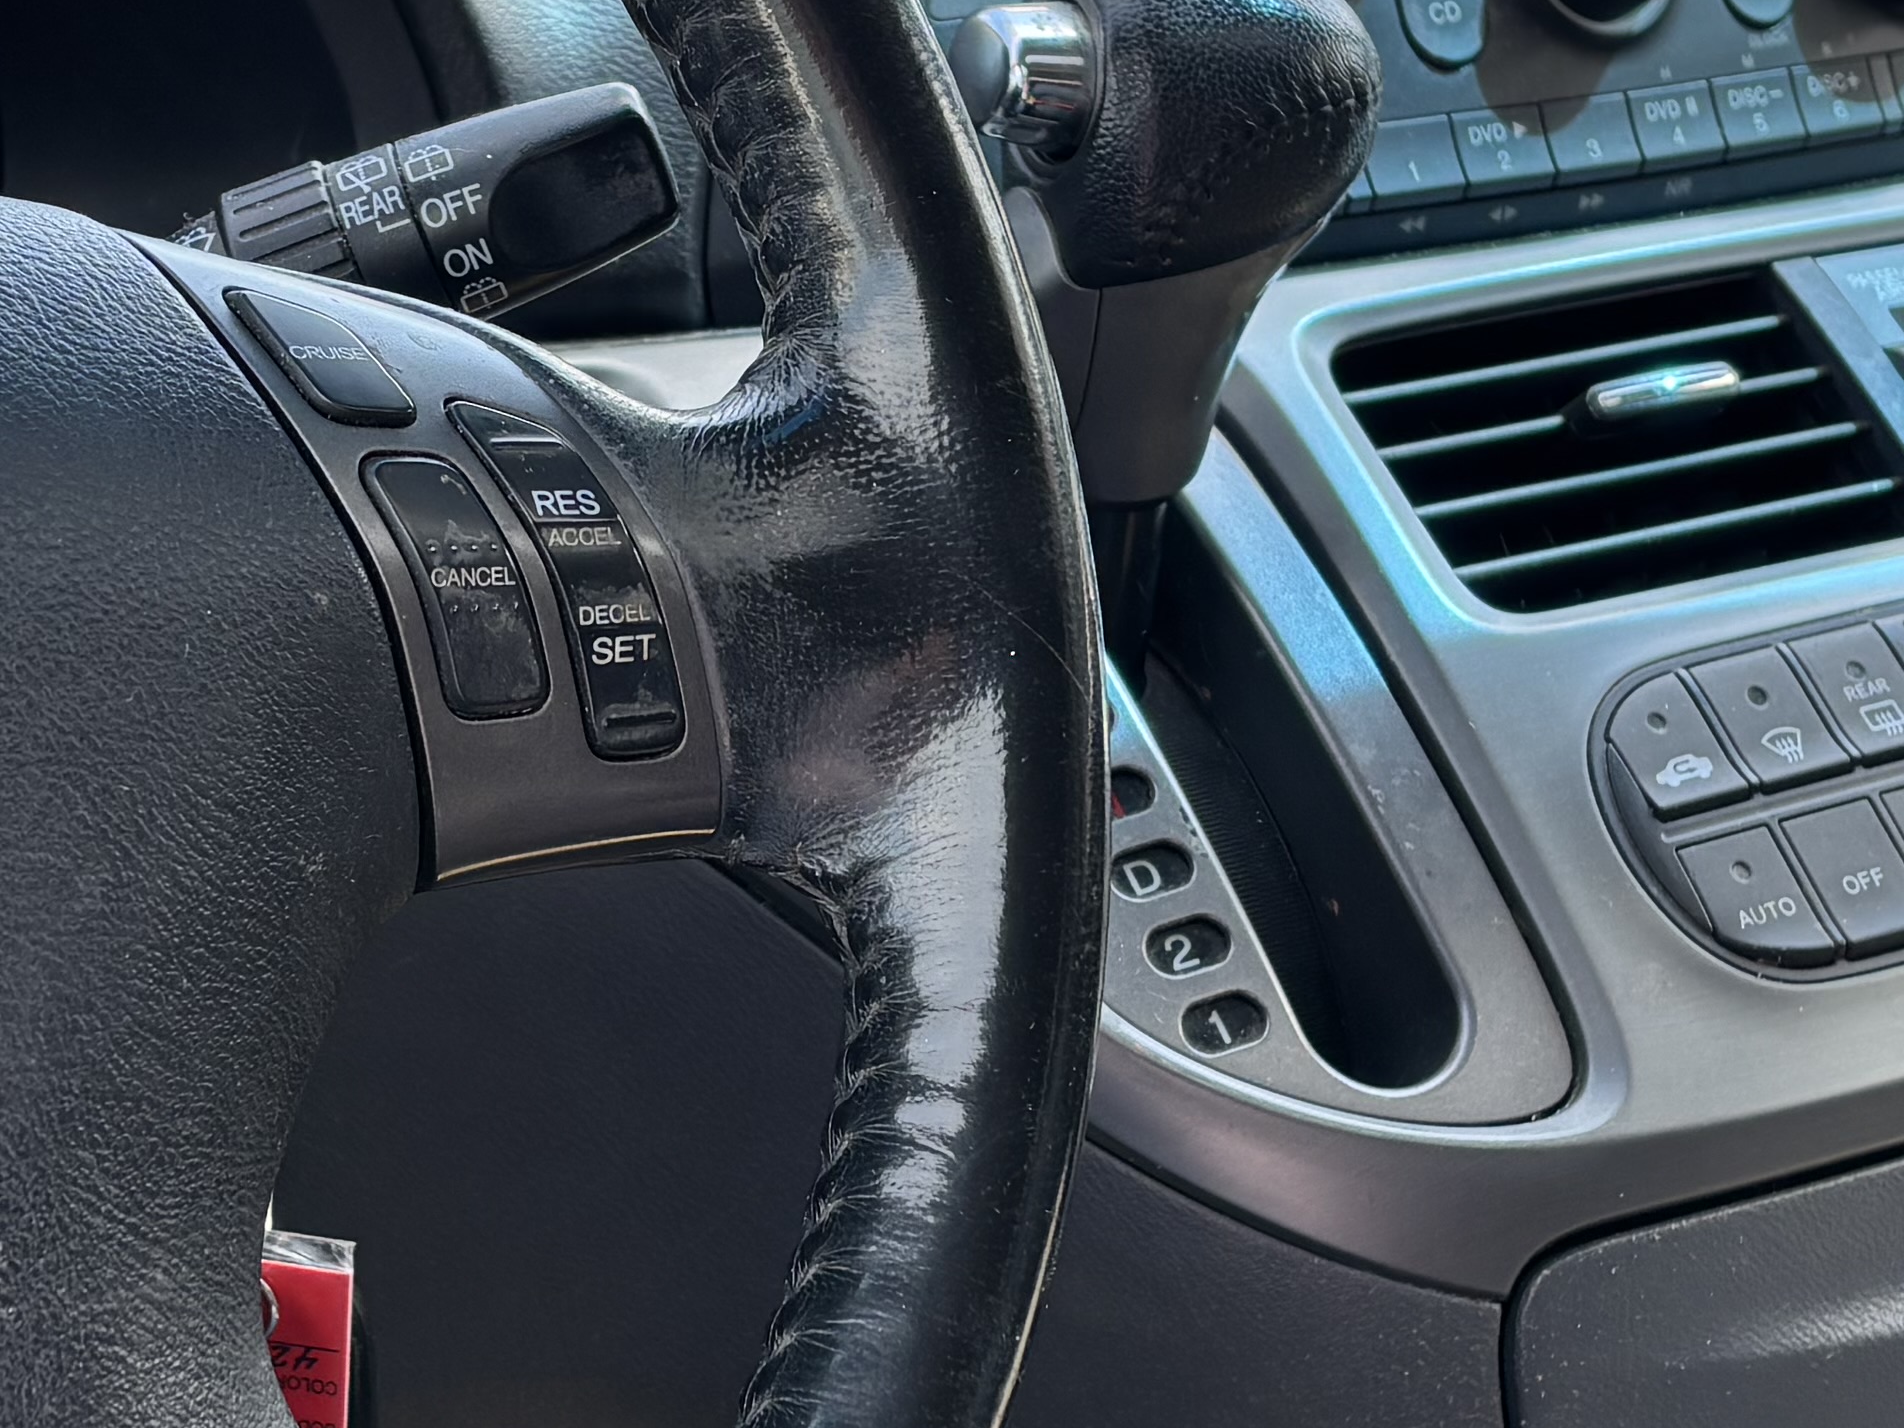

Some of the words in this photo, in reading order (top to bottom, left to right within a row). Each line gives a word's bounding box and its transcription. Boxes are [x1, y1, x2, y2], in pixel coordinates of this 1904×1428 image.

[1428, 0, 1463, 26] CD
[1644, 97, 1682, 122] DVD
[1831, 99, 1851, 121] 6
[1467, 122, 1507, 147] DVD
[1672, 125, 1686, 147] 4
[1752, 112, 1770, 136] 5
[1497, 150, 1513, 172] 2
[1585, 137, 1603, 160] 3
[1407, 159, 1421, 183] 1
[336, 184, 407, 231] REAR
[419, 182, 484, 230] OFF
[441, 237, 496, 279] ON
[288, 344, 369, 363] CRUISE
[530, 488, 602, 520] RES
[547, 526, 623, 548] ACCEL
[430, 565, 517, 589] CANCEL
[577, 603, 652, 628] DECEL
[590, 633, 657, 666] SET
[1842, 677, 1892, 704] REAR
[1121, 858, 1164, 897] D
[1841, 866, 1885, 897] OFF
[1737, 896, 1798, 930] AUTO
[1163, 933, 1201, 973] 2
[1207, 1009, 1233, 1046] 1
